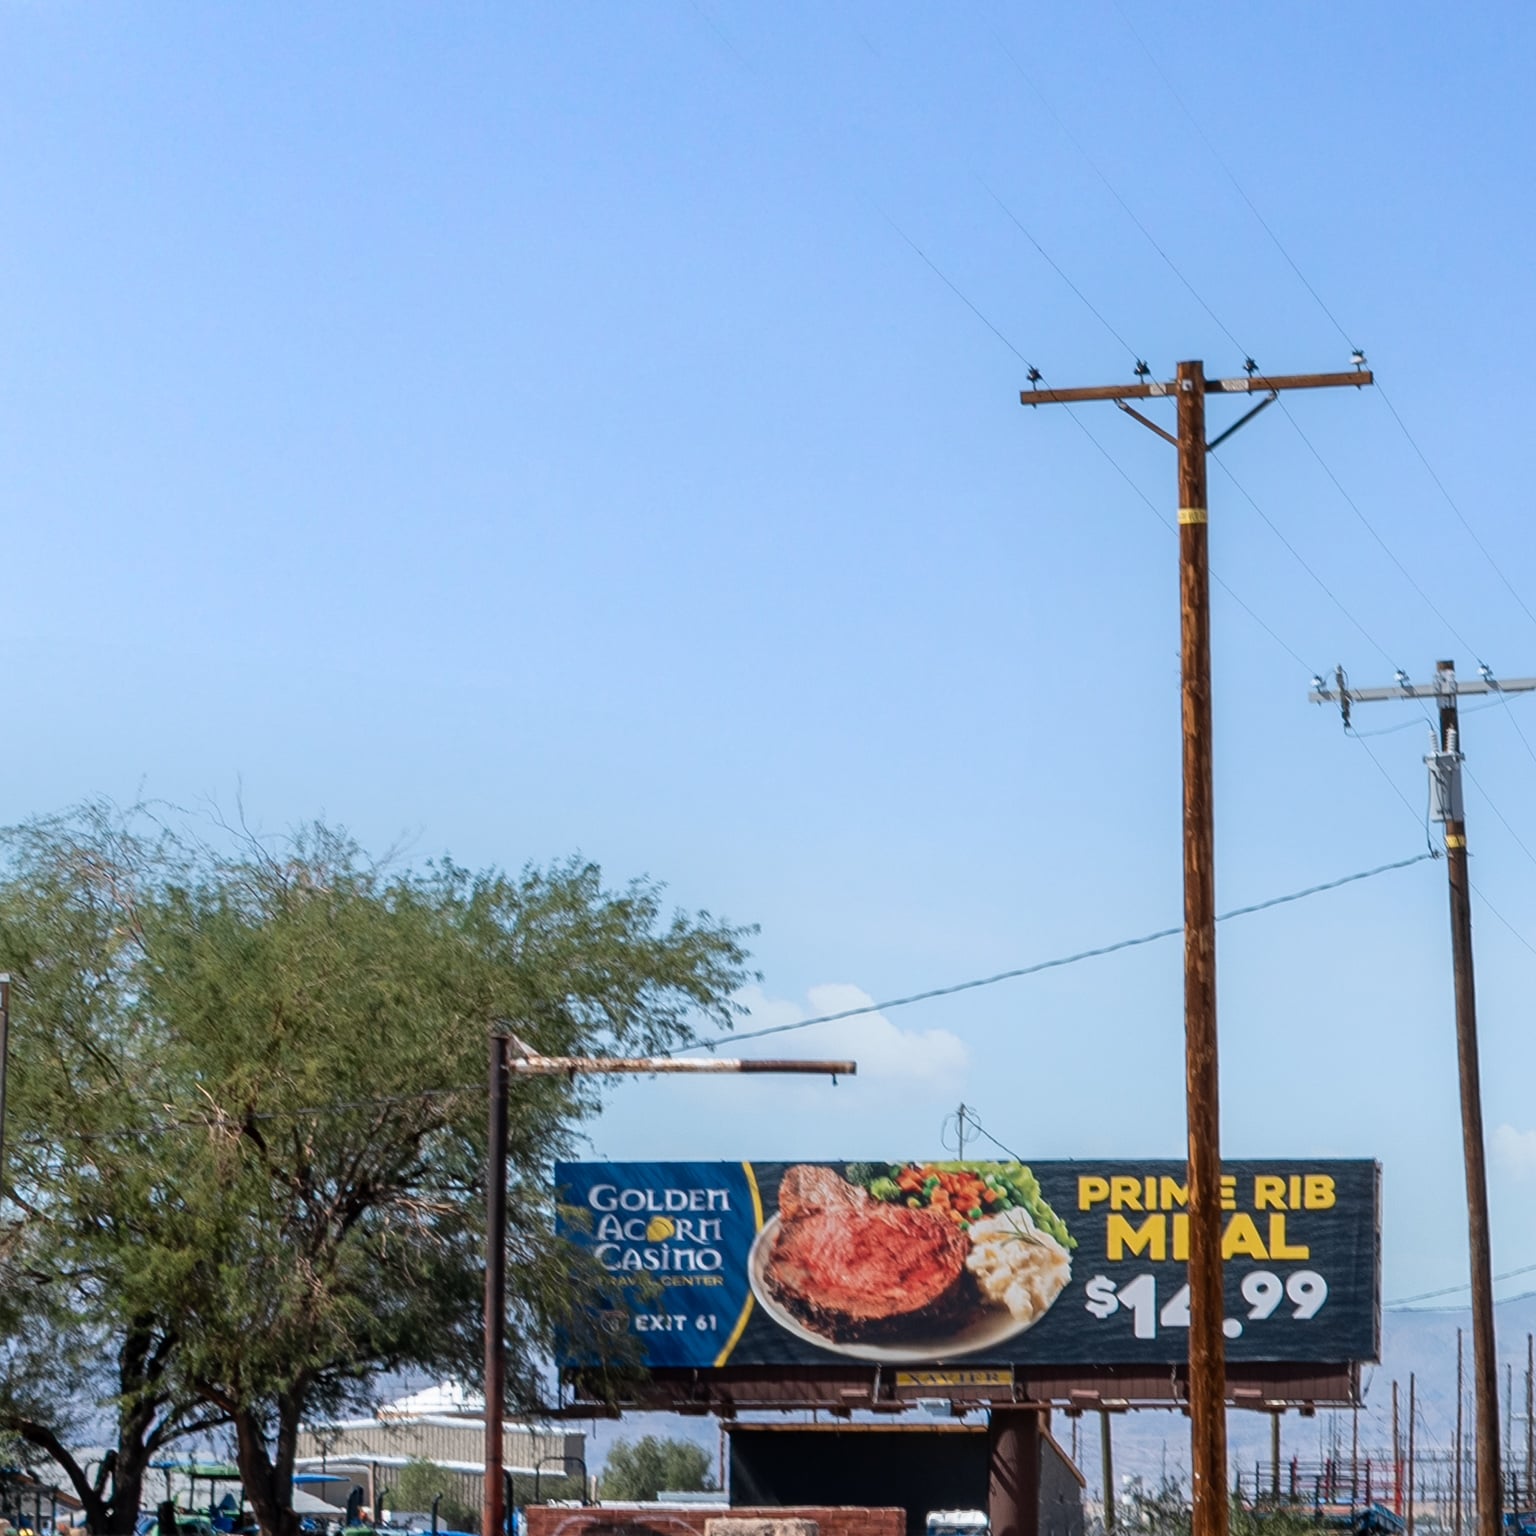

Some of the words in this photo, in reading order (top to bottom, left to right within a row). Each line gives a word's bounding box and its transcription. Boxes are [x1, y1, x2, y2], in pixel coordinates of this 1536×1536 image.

[588, 1184, 732, 1212] GOLDEN
[1078, 1175, 1237, 1211] PRIME
[1254, 1174, 1336, 1210] RIB
[660, 1275, 724, 1287] CENTER
[635, 1314, 687, 1332] EXIT
[695, 1314, 717, 1332] 61
